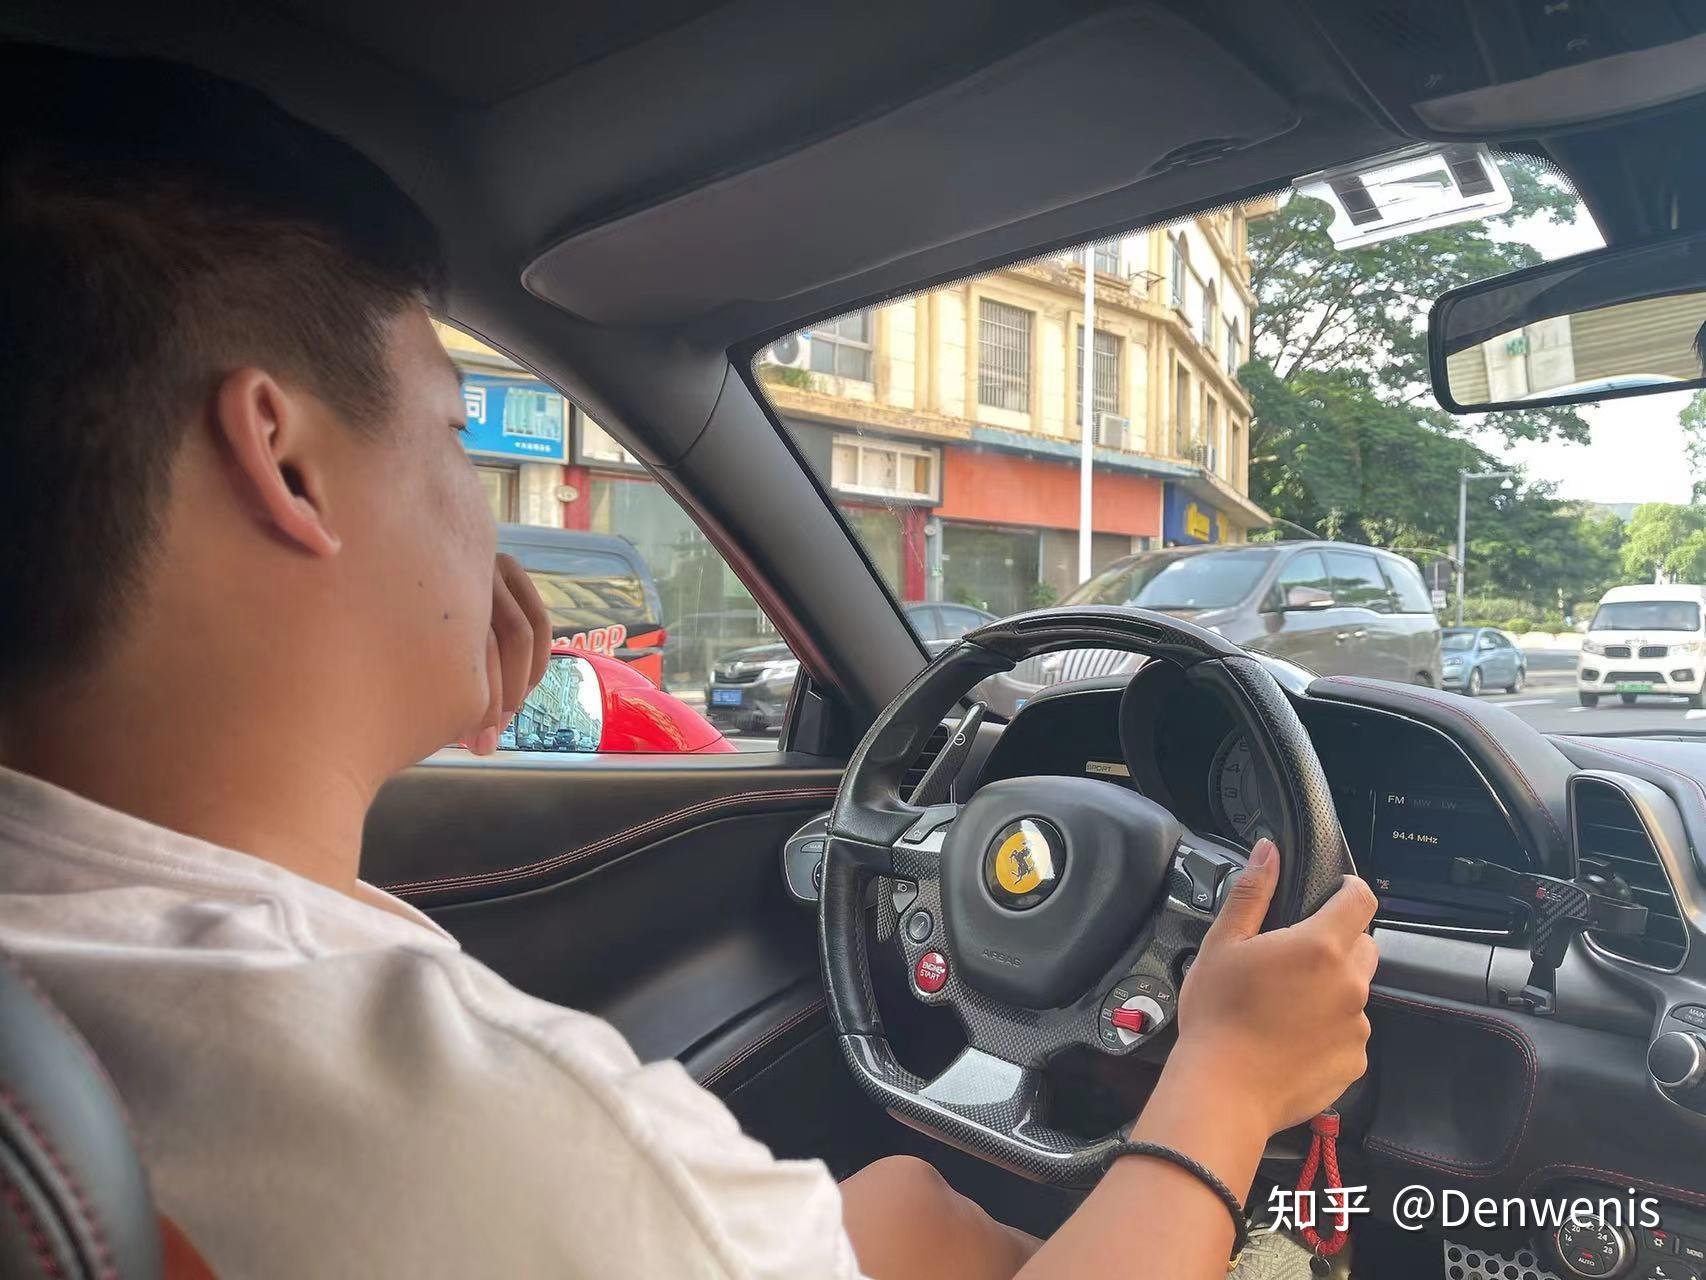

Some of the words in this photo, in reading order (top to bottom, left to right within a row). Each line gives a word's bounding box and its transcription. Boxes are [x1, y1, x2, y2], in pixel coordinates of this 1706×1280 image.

[464, 385, 486, 424] 司
[1387, 795, 1405, 805] FM
[1391, 830, 1414, 841] 94.4
[1416, 834, 1438, 844] MHz
[920, 970, 940, 981] START
[1688, 1008, 1705, 1018] MAIN
[1564, 1233, 1572, 1242] 16
[1597, 1232, 1608, 1242] 24
[1578, 1257, 1595, 1267] AUTO
